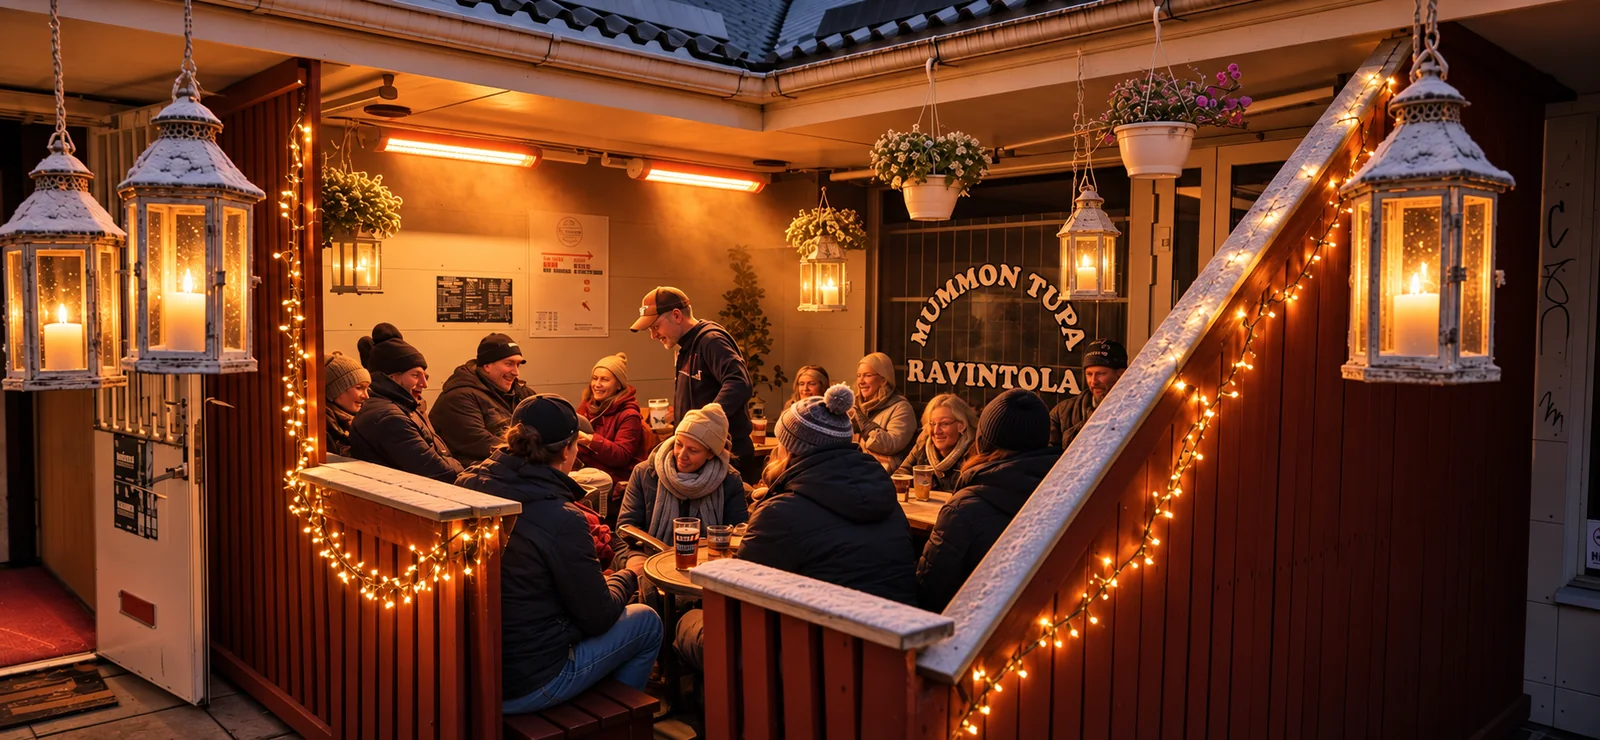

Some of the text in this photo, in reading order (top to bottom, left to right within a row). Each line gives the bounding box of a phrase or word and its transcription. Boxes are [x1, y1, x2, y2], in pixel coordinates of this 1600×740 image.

[910, 263, 1086, 352] MUMMON TUPA
[906, 359, 1082, 395] RAVINTOLA
